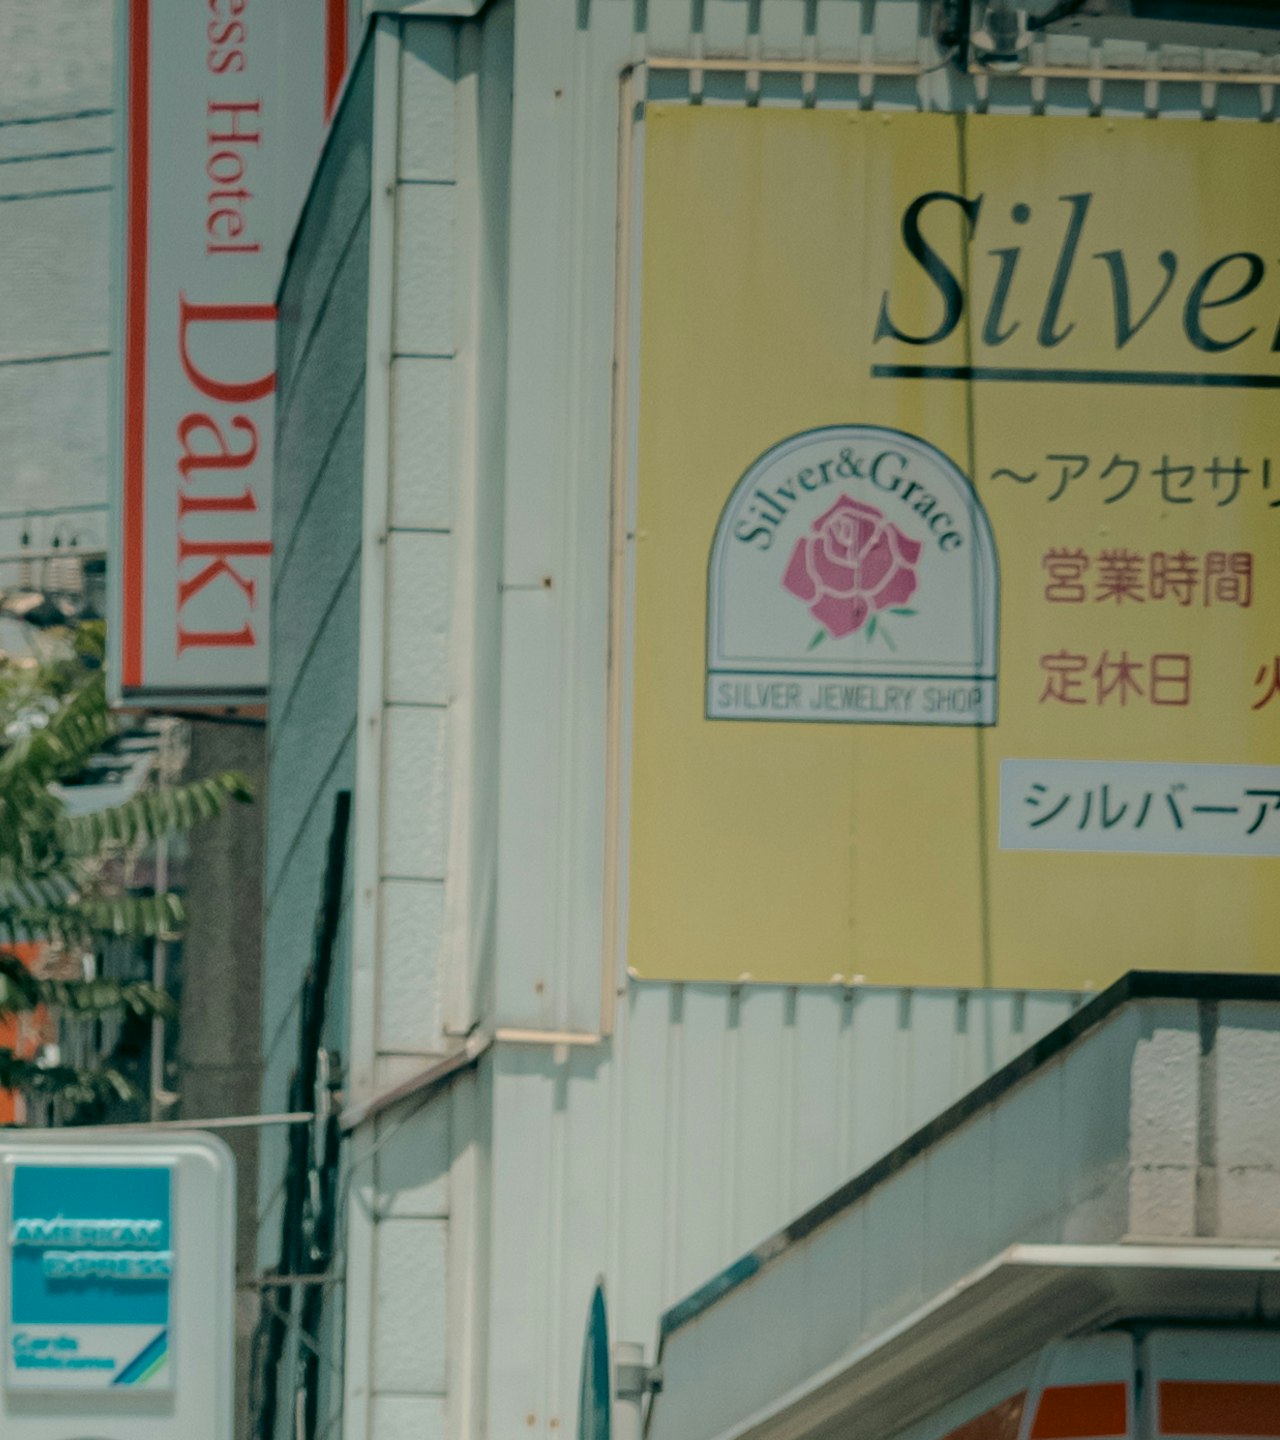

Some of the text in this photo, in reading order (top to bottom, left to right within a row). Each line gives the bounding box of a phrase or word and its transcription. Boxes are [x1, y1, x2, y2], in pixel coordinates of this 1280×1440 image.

[206, 98, 262, 255] Hotel
[872, 190, 1280, 354] Silve
[176, 291, 279, 661] Daiki
[735, 448, 963, 552] Silver&Grace
[1042, 546, 1254, 608] 営業時間
[717, 682, 983, 713] SILVER JEWELRY SHOP
[1038, 649, 1192, 707] 定休日
